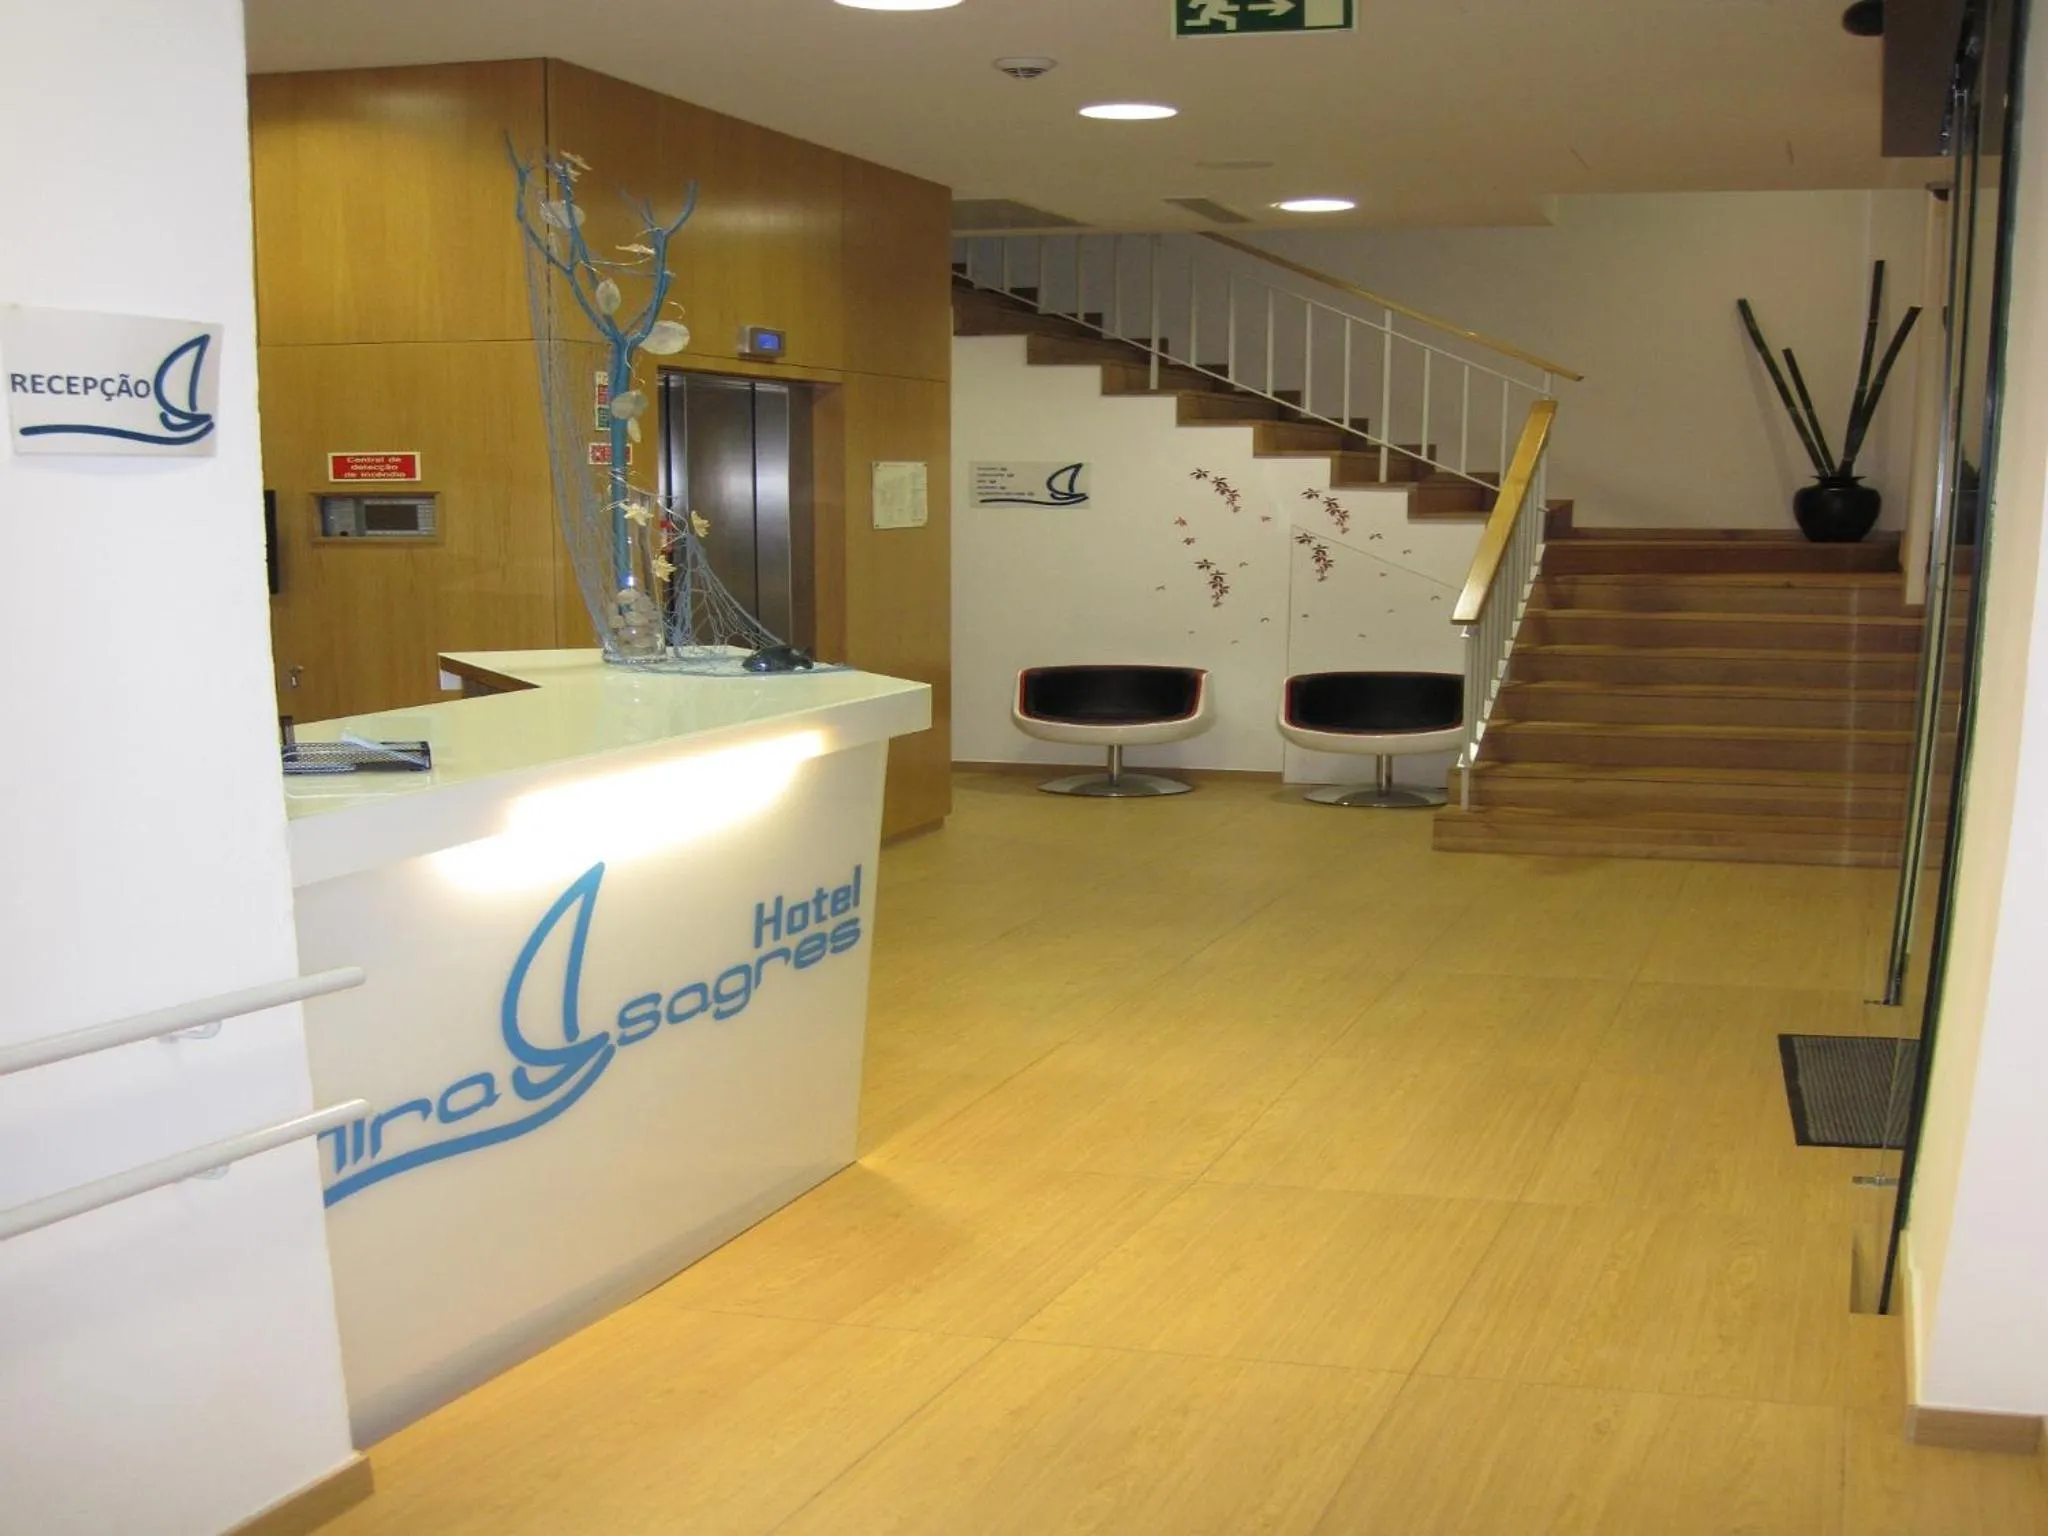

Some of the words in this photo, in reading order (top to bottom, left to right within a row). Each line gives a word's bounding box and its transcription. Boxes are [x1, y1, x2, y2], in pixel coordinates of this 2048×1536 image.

[10, 372, 151, 402] RECEPÇÃO
[753, 863, 862, 950] Hotel
[616, 916, 862, 1047] sagres
